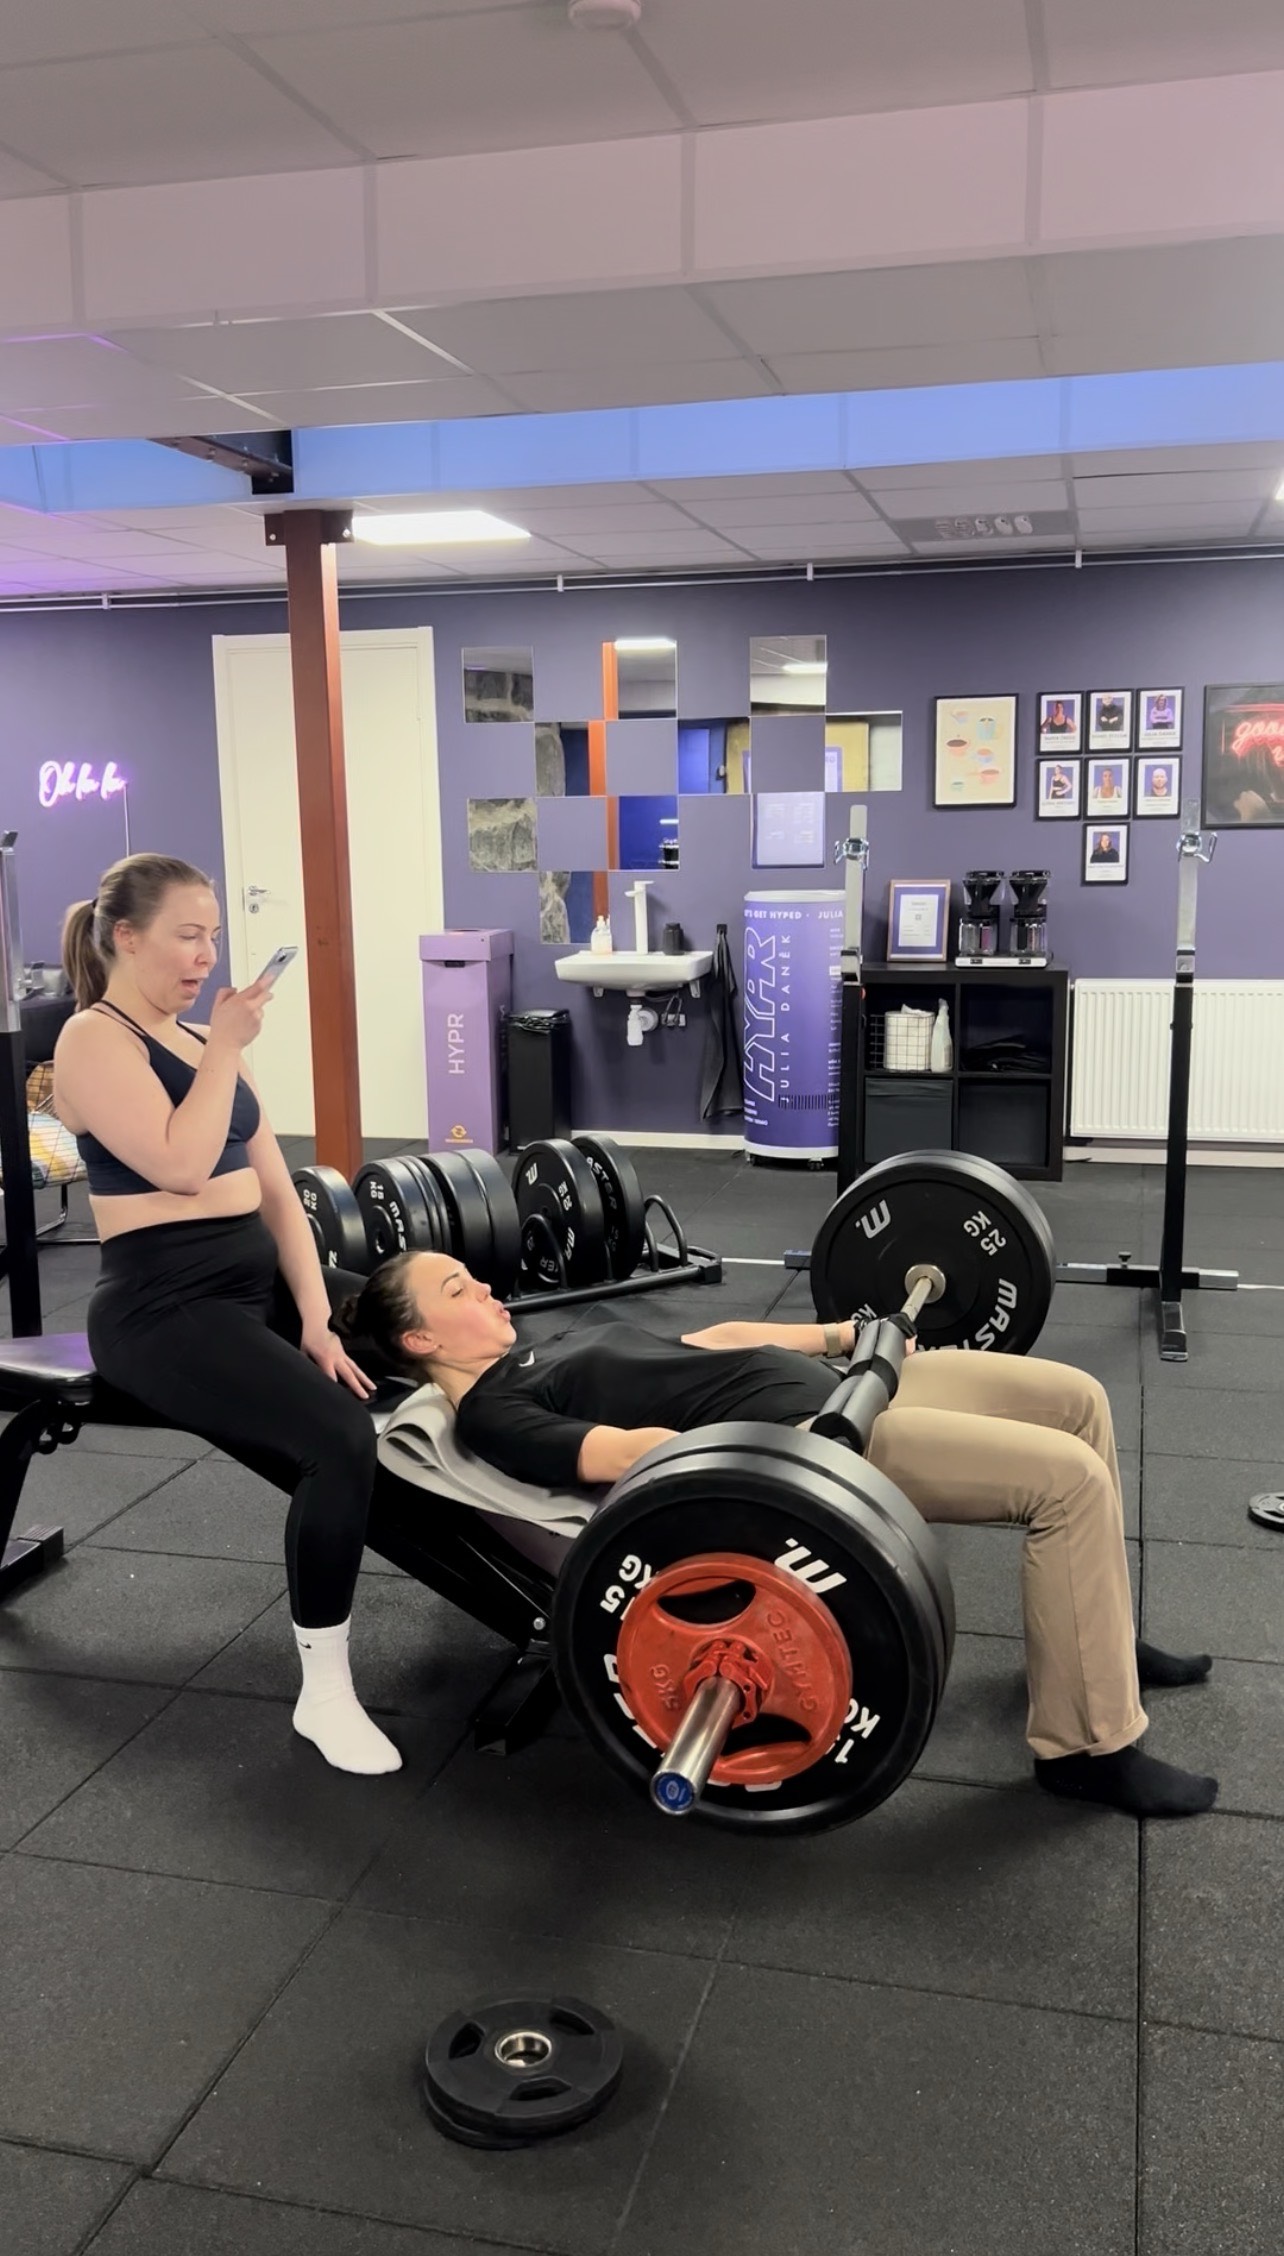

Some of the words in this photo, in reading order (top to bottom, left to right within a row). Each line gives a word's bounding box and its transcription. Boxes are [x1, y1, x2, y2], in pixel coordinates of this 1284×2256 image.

[769, 911, 803, 920] HYPED
[447, 1013, 465, 1075] HYPR
[780, 1032, 790, 1103] JULIA
[389, 1200, 407, 1252] MAS
[963, 1210, 992, 1237] KG
[979, 1228, 1007, 1257] 25
[767, 1609, 819, 1712] GYMTEC
